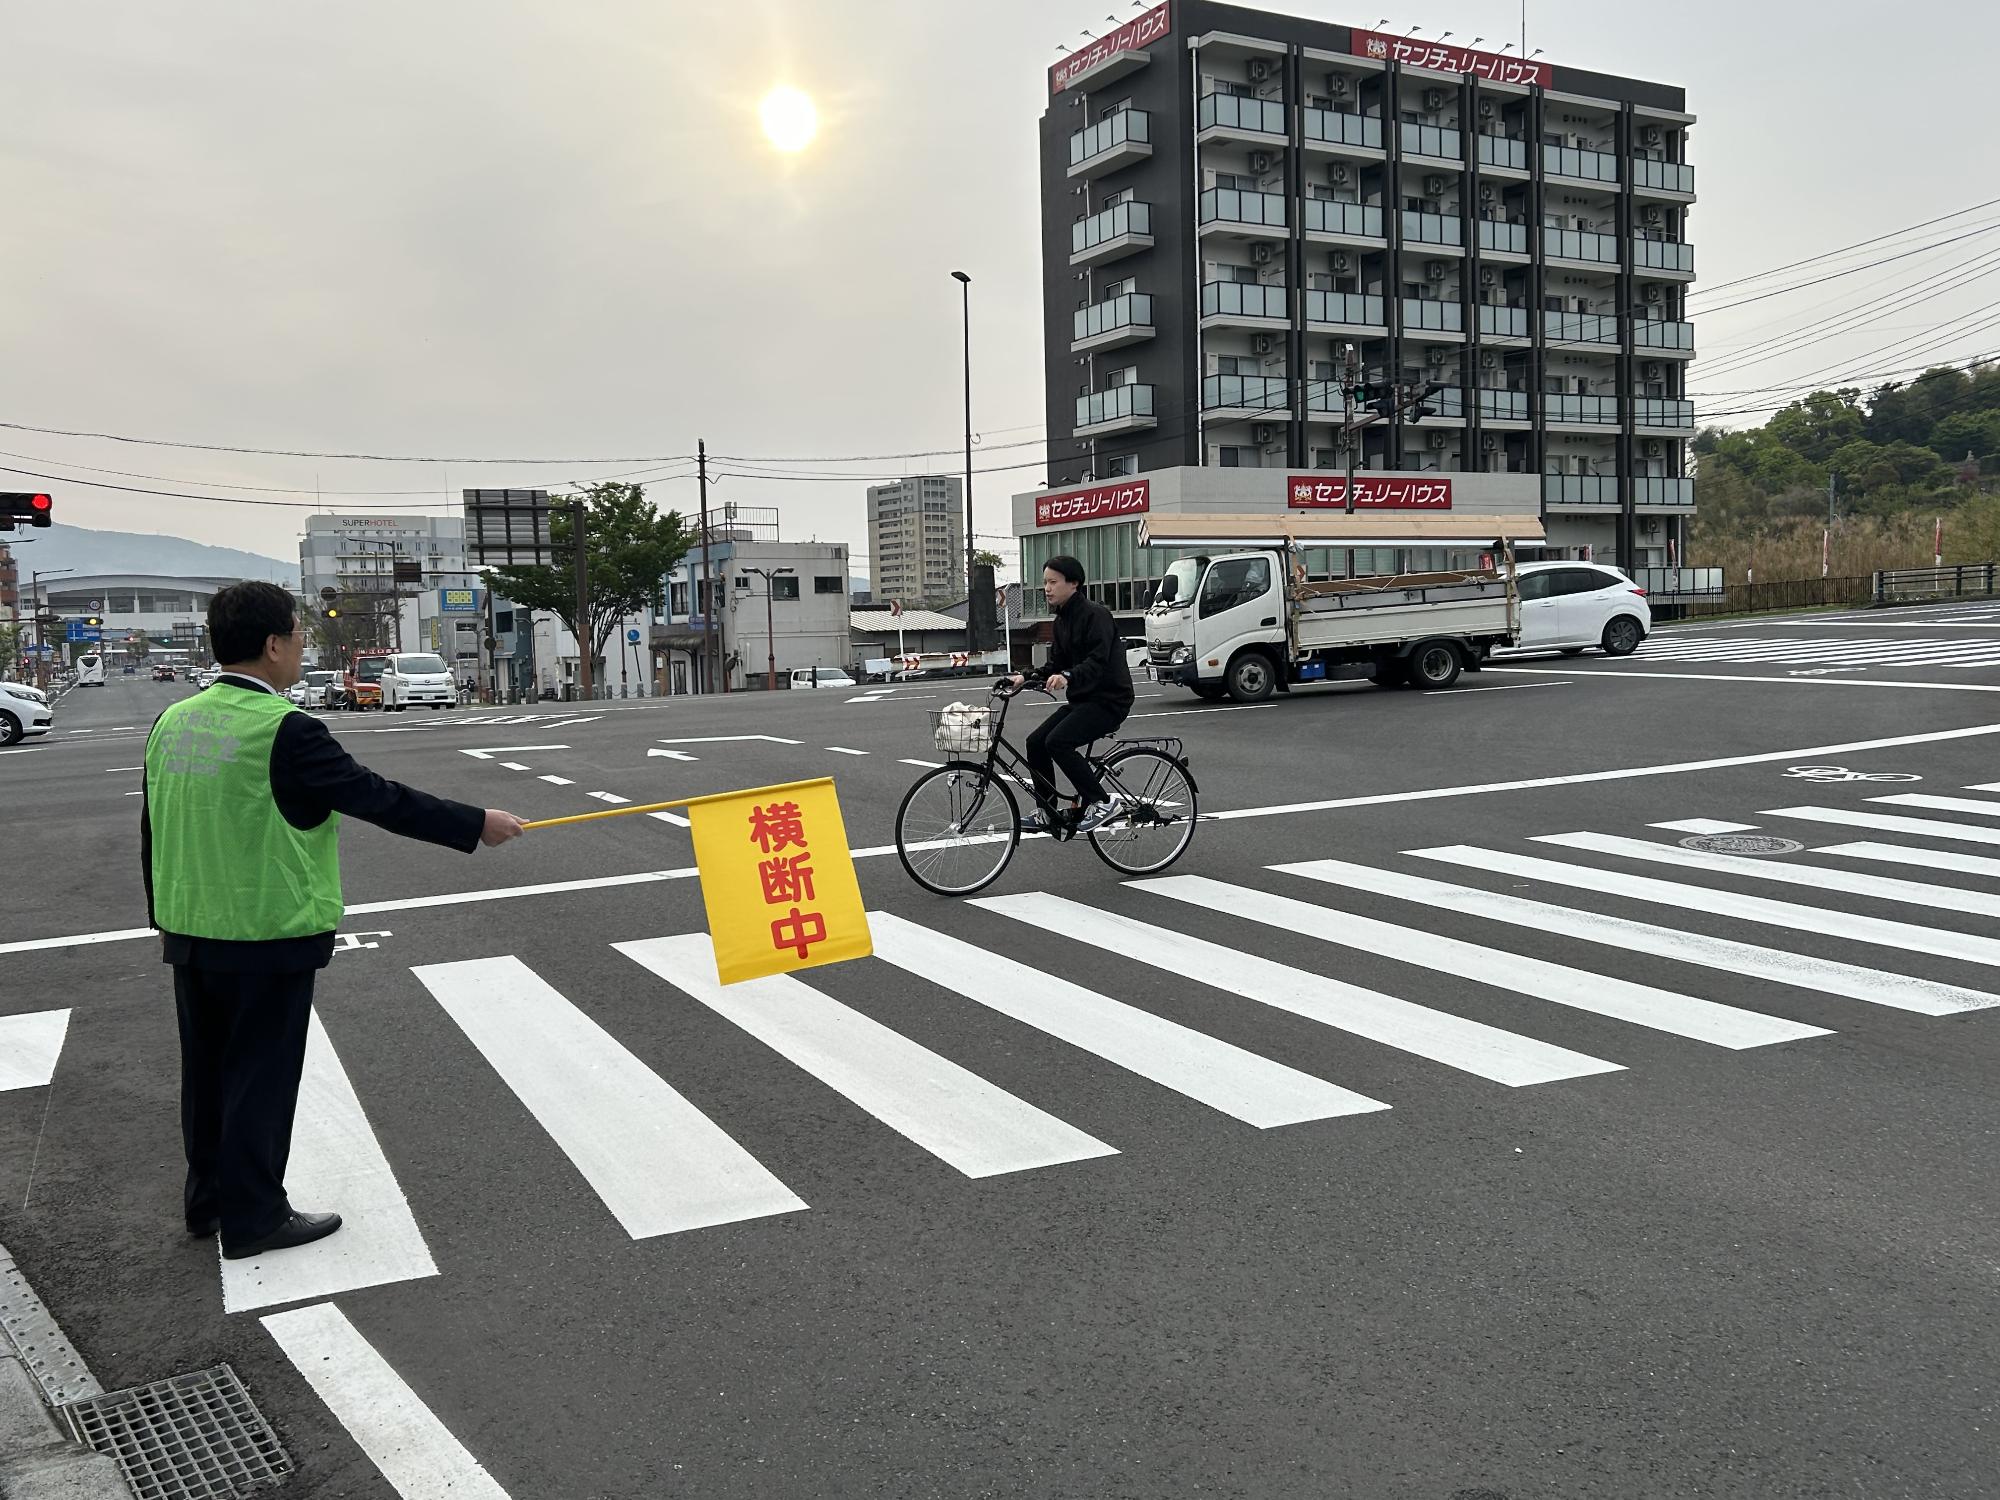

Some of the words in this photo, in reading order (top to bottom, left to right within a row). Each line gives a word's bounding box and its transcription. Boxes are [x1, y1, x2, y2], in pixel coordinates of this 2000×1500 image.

[1069, 9, 1166, 77] センチュリーハウス
[1392, 40, 1540, 84] センチュリーハウス
[1052, 486, 1145, 518] センチュリーハウス
[748, 801, 827, 960] 横断中
